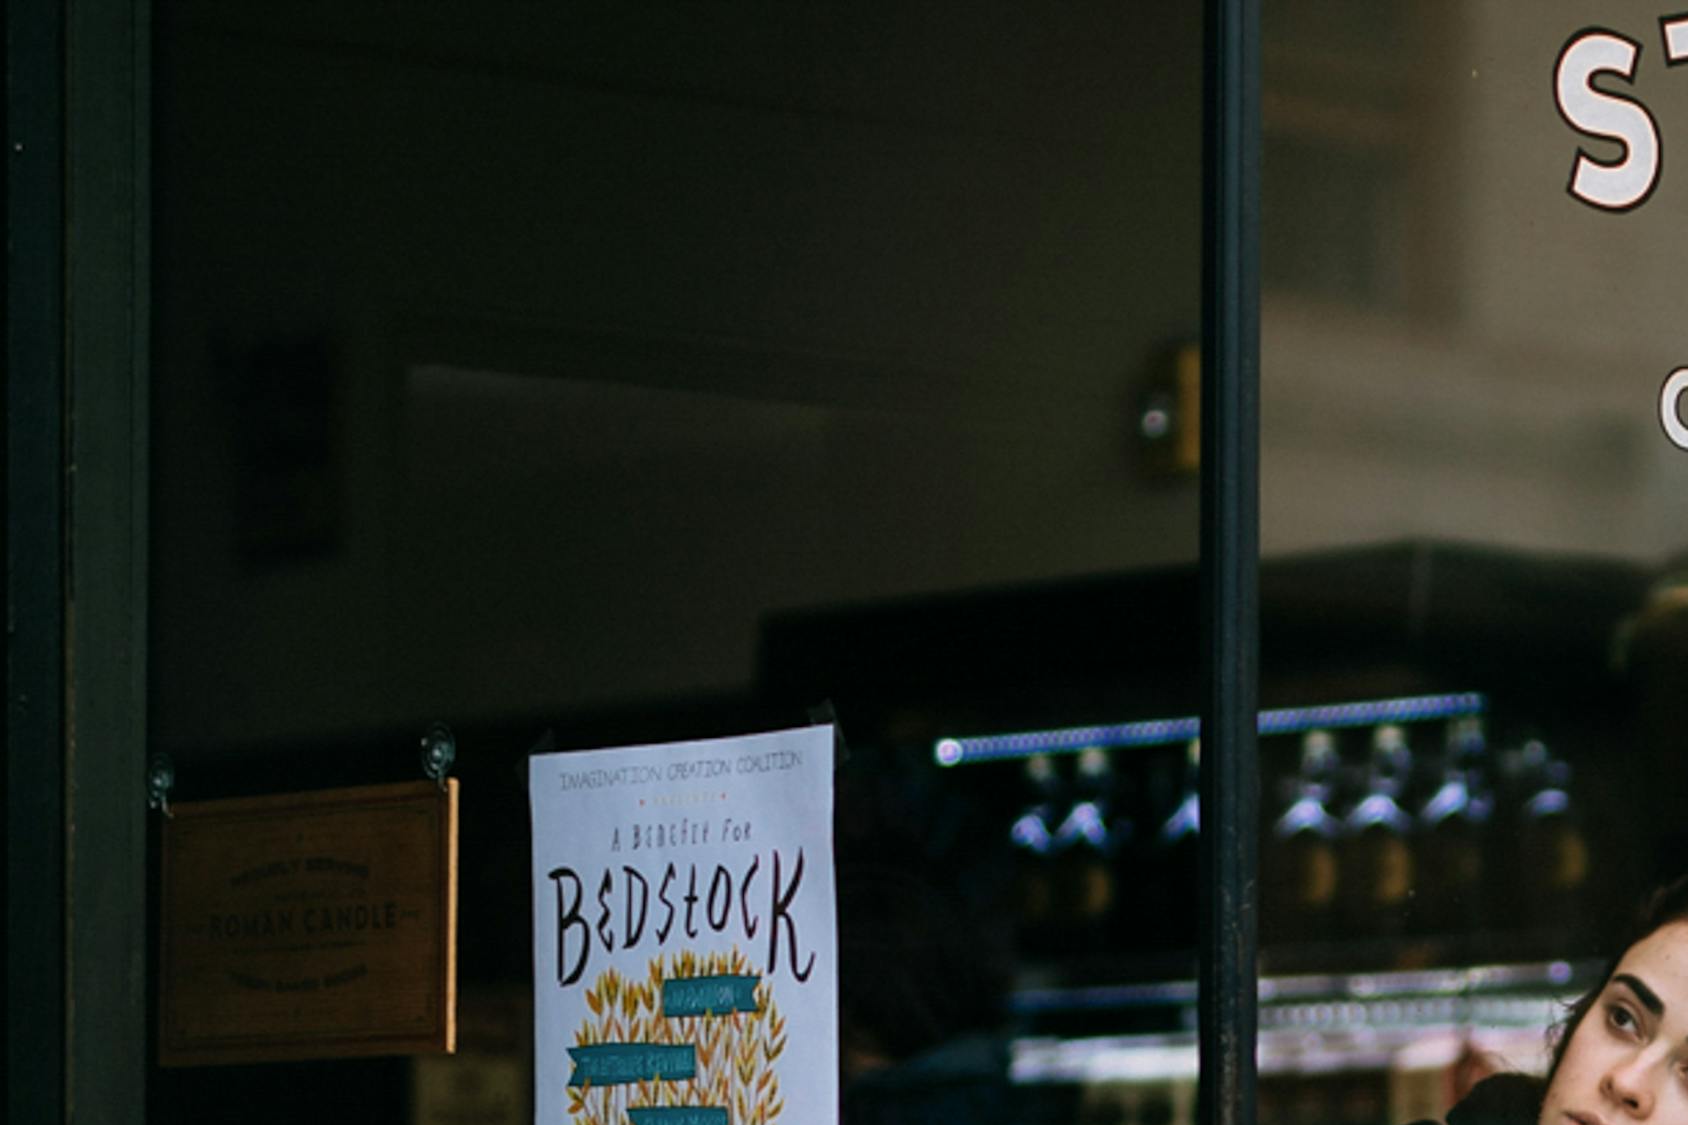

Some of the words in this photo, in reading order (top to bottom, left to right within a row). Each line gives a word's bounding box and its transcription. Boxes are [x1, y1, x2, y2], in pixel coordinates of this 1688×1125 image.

[559, 766, 663, 791] IMAGINATION
[667, 760, 733, 781] CREATION
[736, 750, 804, 775] COALITION
[611, 827, 621, 852] A
